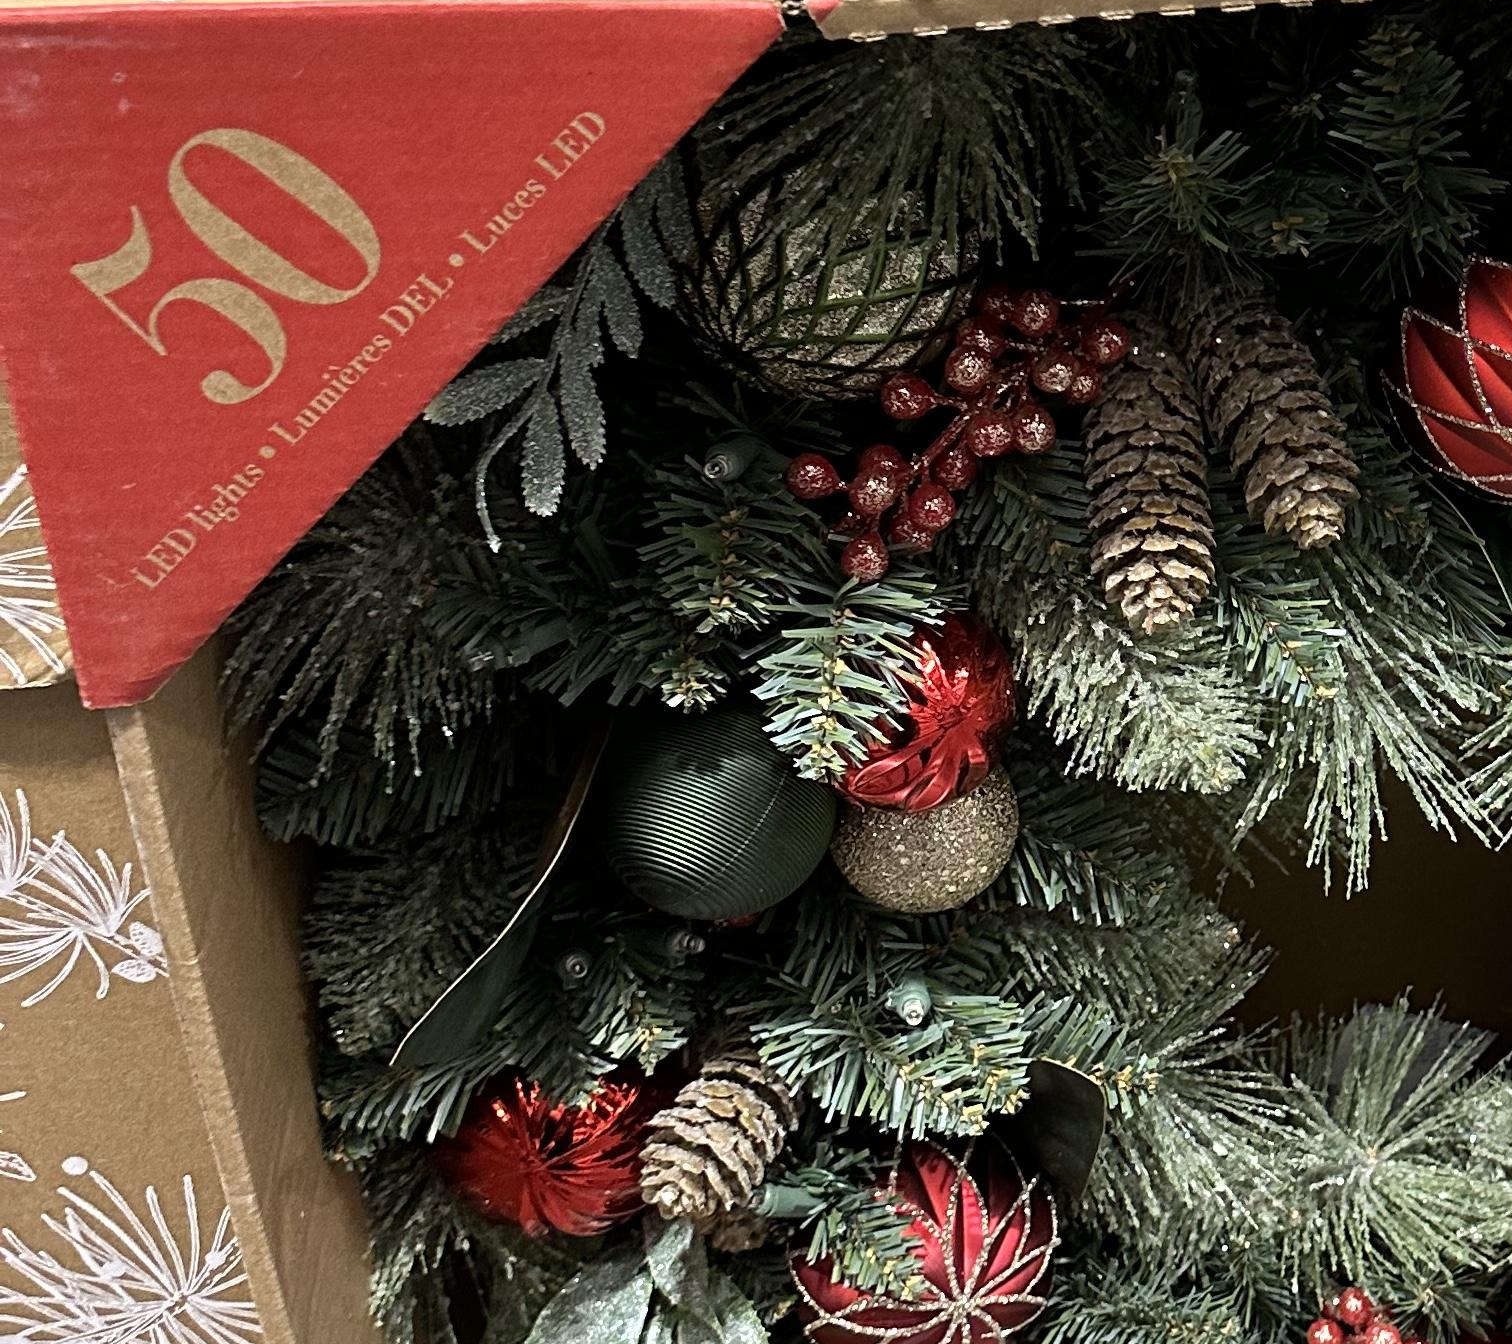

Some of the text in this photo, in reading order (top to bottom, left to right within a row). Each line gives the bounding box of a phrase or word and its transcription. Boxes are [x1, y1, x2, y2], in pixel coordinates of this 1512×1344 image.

[70, 128, 381, 405] 50
[129, 111, 606, 589] LED lights Lumières DEL Luces LED
